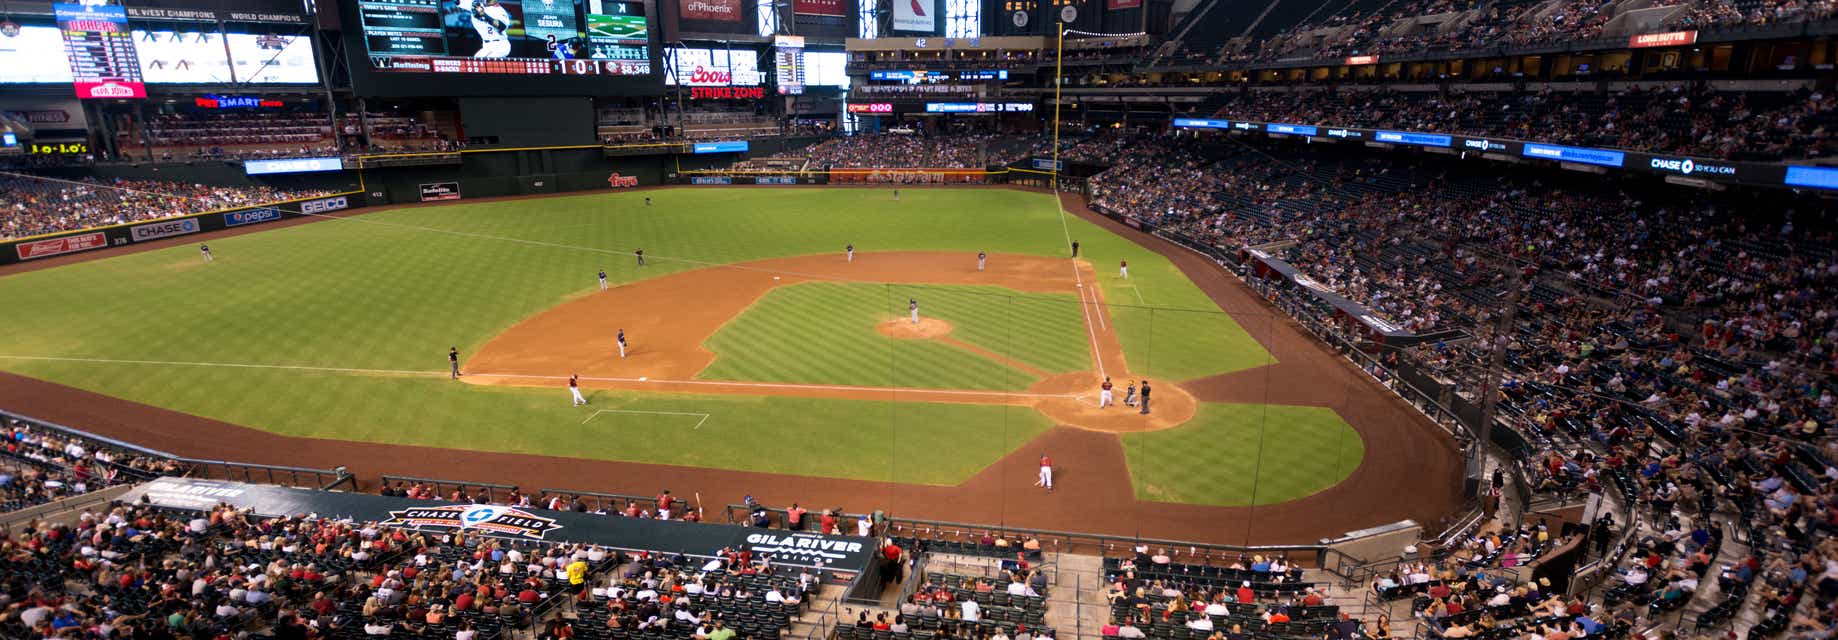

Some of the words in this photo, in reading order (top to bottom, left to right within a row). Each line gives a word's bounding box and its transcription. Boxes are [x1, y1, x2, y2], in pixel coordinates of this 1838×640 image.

[141, 9, 165, 17] WEST
[167, 10, 216, 19] CHAMPIONS
[688, 3, 699, 12] of
[699, 4, 733, 14] Phoenix
[231, 13, 257, 21] WORLD
[259, 14, 301, 22] CHAMPIONS
[537, 20, 564, 28] SEGURA
[547, 34, 557, 51] 2
[914, 38, 926, 47] 42
[393, 62, 430, 70] Refining
[560, 60, 567, 74] 1
[576, 60, 586, 74] 0
[593, 60, 600, 74] 1
[620, 65, 650, 75] $8,349
[690, 65, 731, 83] Coors
[691, 87, 731, 98] STRIKE
[731, 87, 764, 98] ZONE
[1465, 140, 1482, 148] CHASE
[1651, 158, 1681, 170] CHASE
[303, 199, 345, 212] GEICO
[244, 209, 273, 223] pepsi
[137, 222, 182, 238] CHASE
[406, 509, 459, 518] CHASE
[498, 515, 544, 528] FIELD
